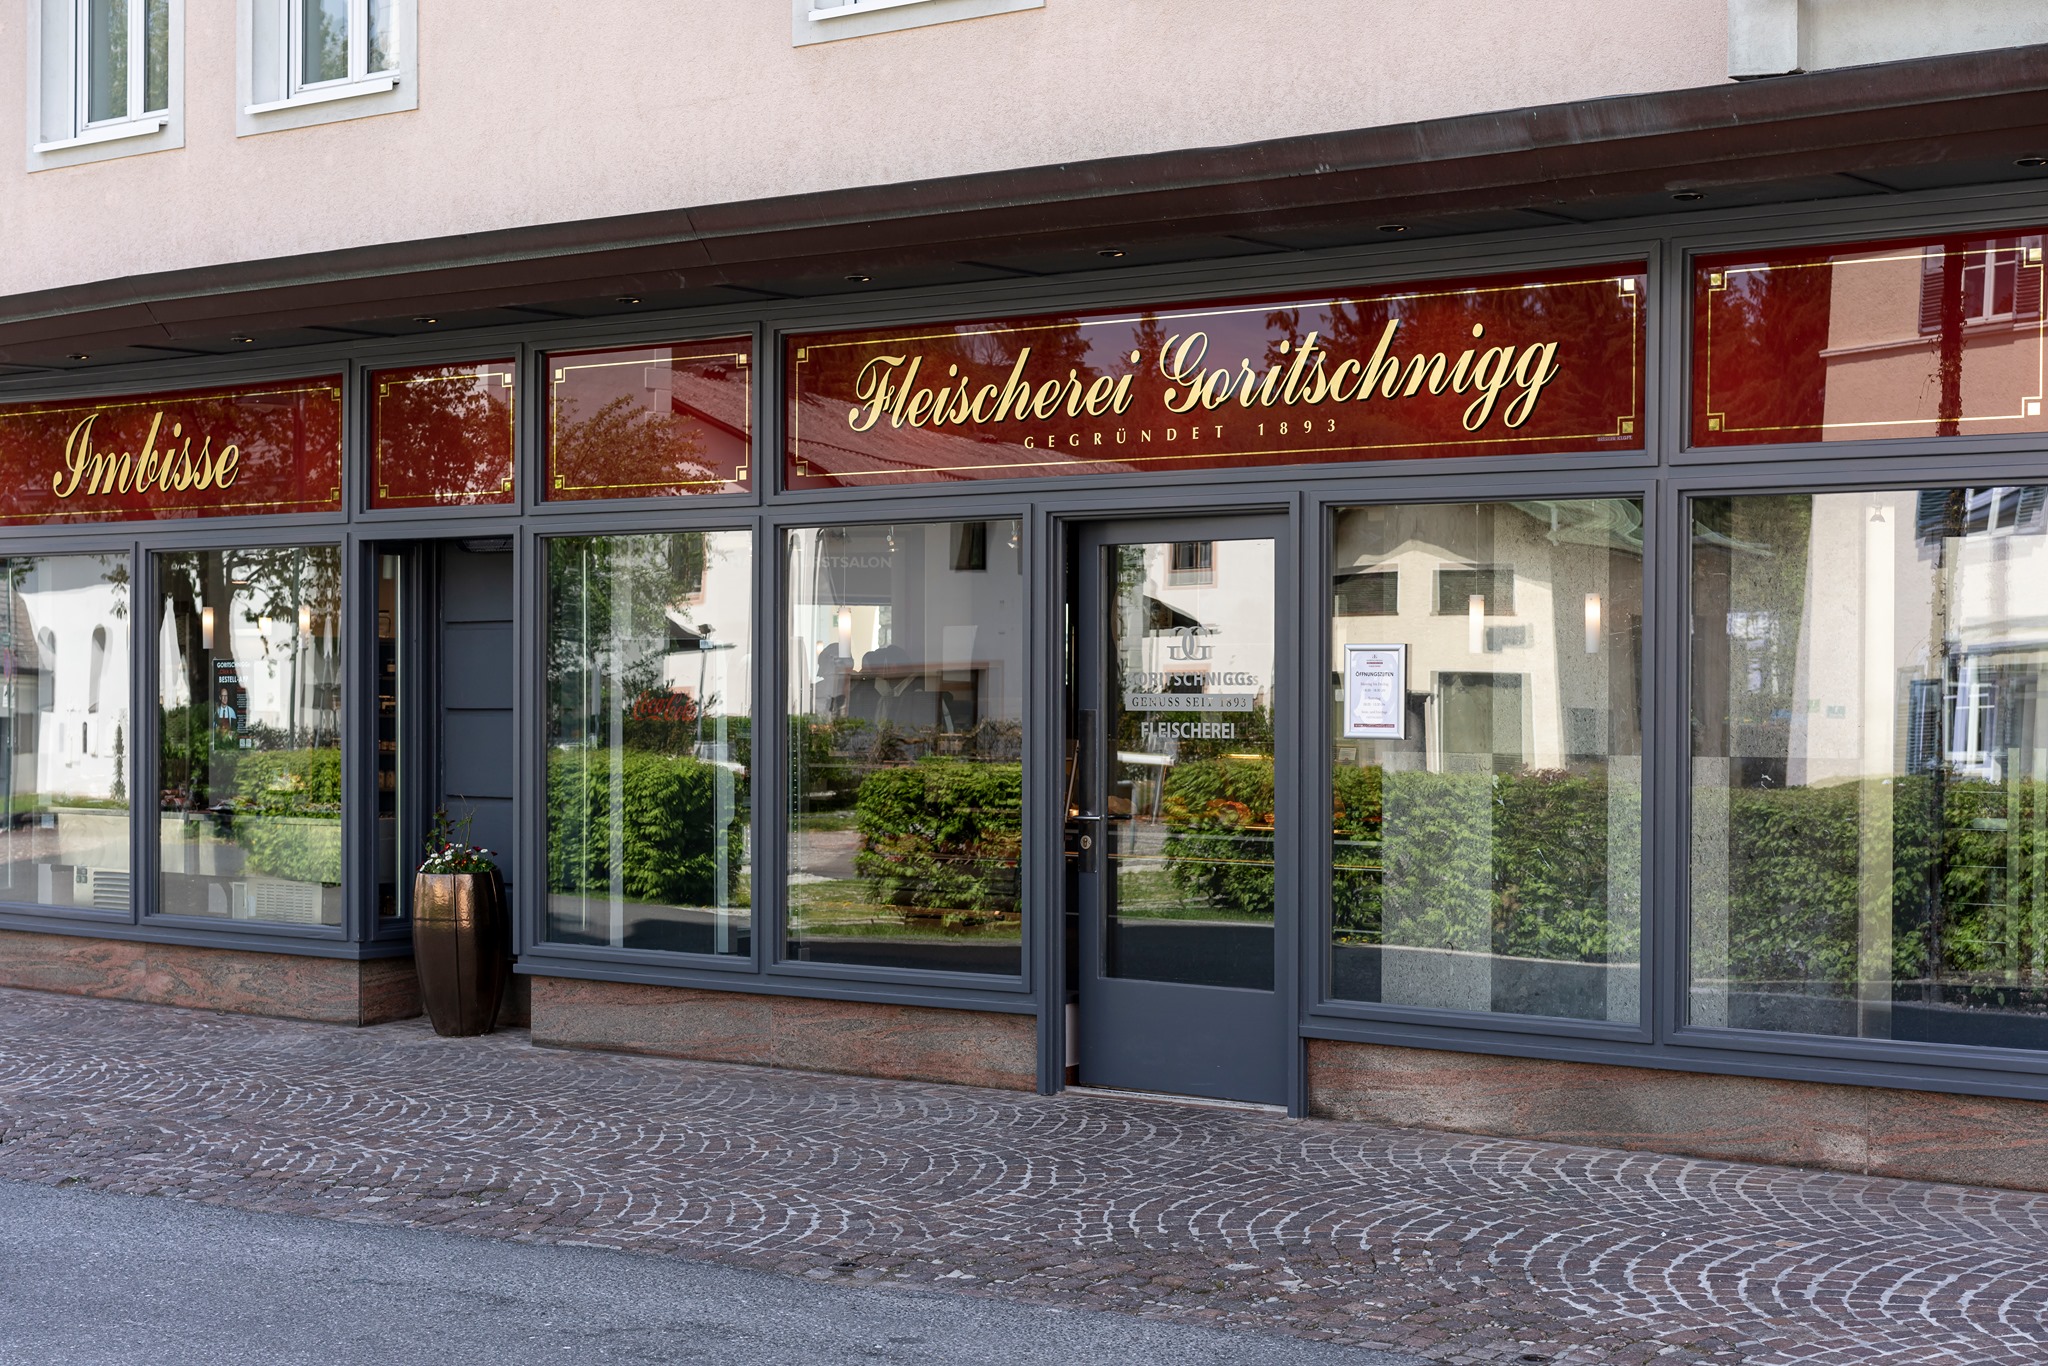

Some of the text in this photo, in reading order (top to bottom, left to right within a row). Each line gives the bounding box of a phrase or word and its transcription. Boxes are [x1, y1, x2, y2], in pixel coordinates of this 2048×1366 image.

[849, 318, 1559, 432] Fleischerei Goritschnigg
[1024, 418, 1336, 449] GEGRÜNDET 1893
[53, 411, 240, 498] Imbisse
[1132, 696, 1247, 708] GENUSS SEIT 1893
[1141, 722, 1235, 738] FLEISCHEREI
